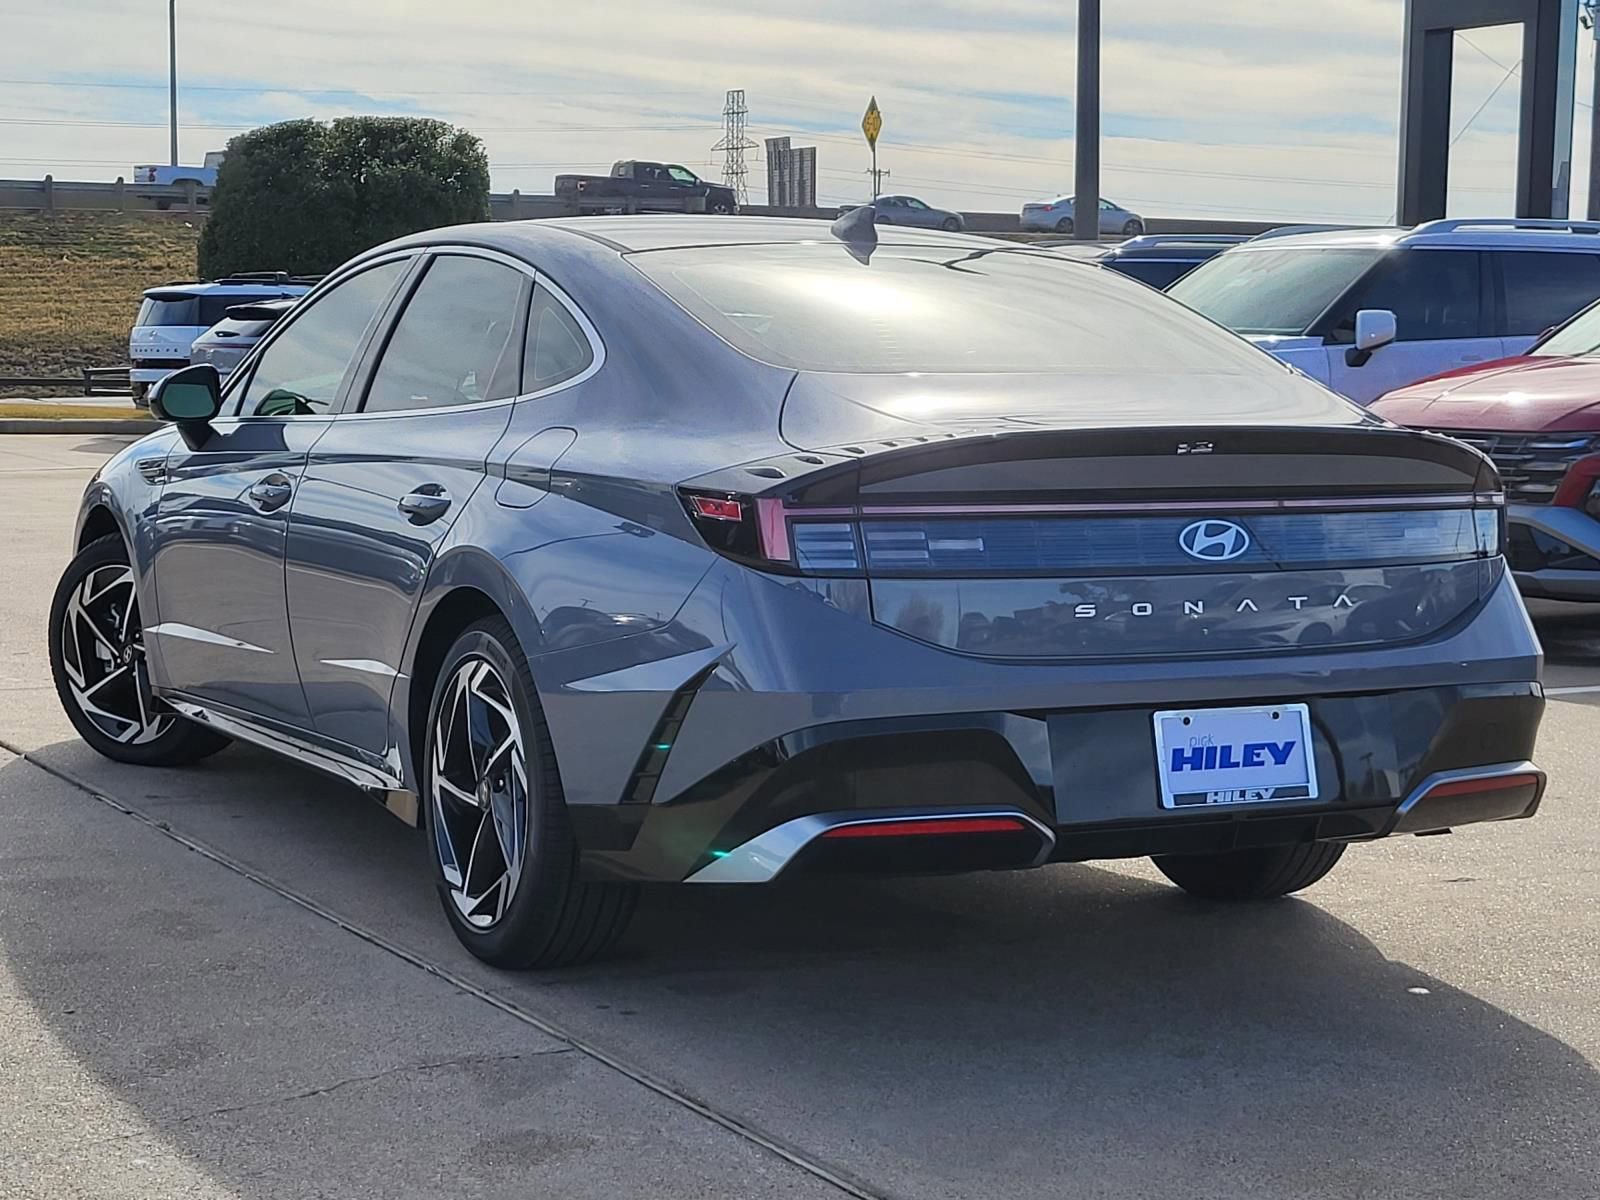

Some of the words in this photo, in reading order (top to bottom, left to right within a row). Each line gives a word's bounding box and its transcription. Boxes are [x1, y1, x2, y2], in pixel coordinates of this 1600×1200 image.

[1074, 594, 1353, 618] SONATA
[1171, 740, 1296, 772] HILEY
[1206, 787, 1277, 804] HILEY
